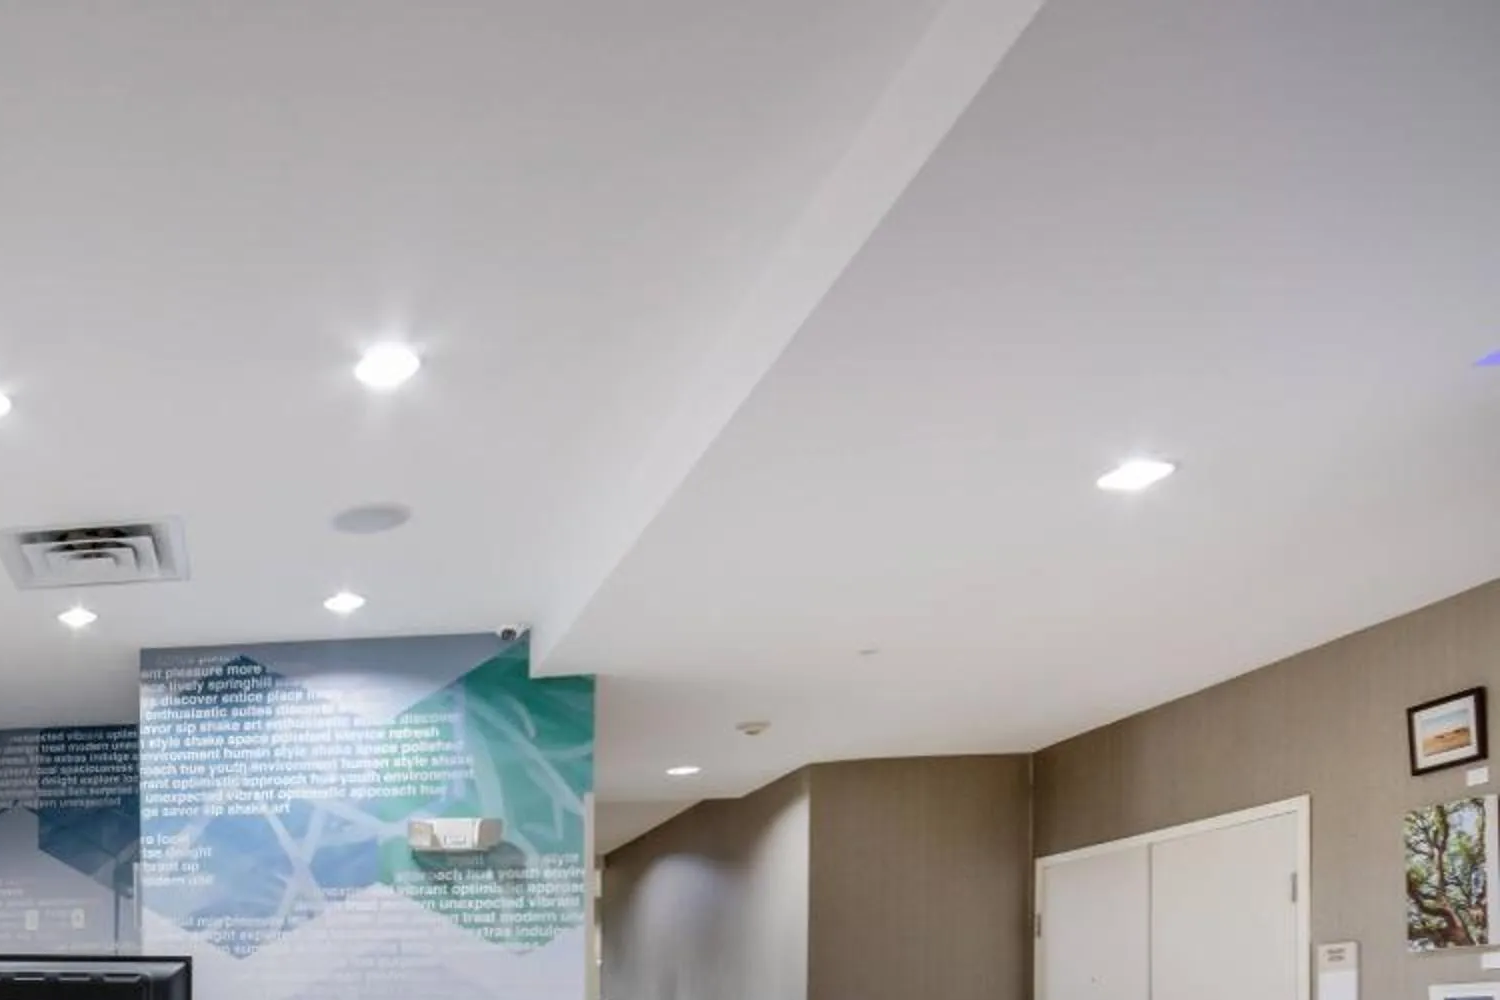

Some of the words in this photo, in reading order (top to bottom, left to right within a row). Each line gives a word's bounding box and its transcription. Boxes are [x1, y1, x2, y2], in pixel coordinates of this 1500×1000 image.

[166, 666, 223, 680] pleasure
[227, 664, 262, 675] more
[169, 679, 204, 695] lively
[208, 676, 272, 692] springhill
[160, 693, 218, 705] discover
[145, 706, 228, 720] enthusiastic
[243, 719, 261, 732] art
[184, 735, 223, 747] shake
[227, 733, 269, 747] space
[389, 727, 440, 740] refresh
[222, 748, 270, 760] human
[208, 761, 248, 778] youth
[384, 767, 475, 782] environment
[227, 788, 274, 802] vibrant
[349, 783, 416, 800] approach
[227, 801, 271, 814] shake
[498, 866, 540, 882] youth
[438, 896, 525, 912] unexpected
[462, 910, 495, 924] treat
[499, 910, 558, 923] modern
